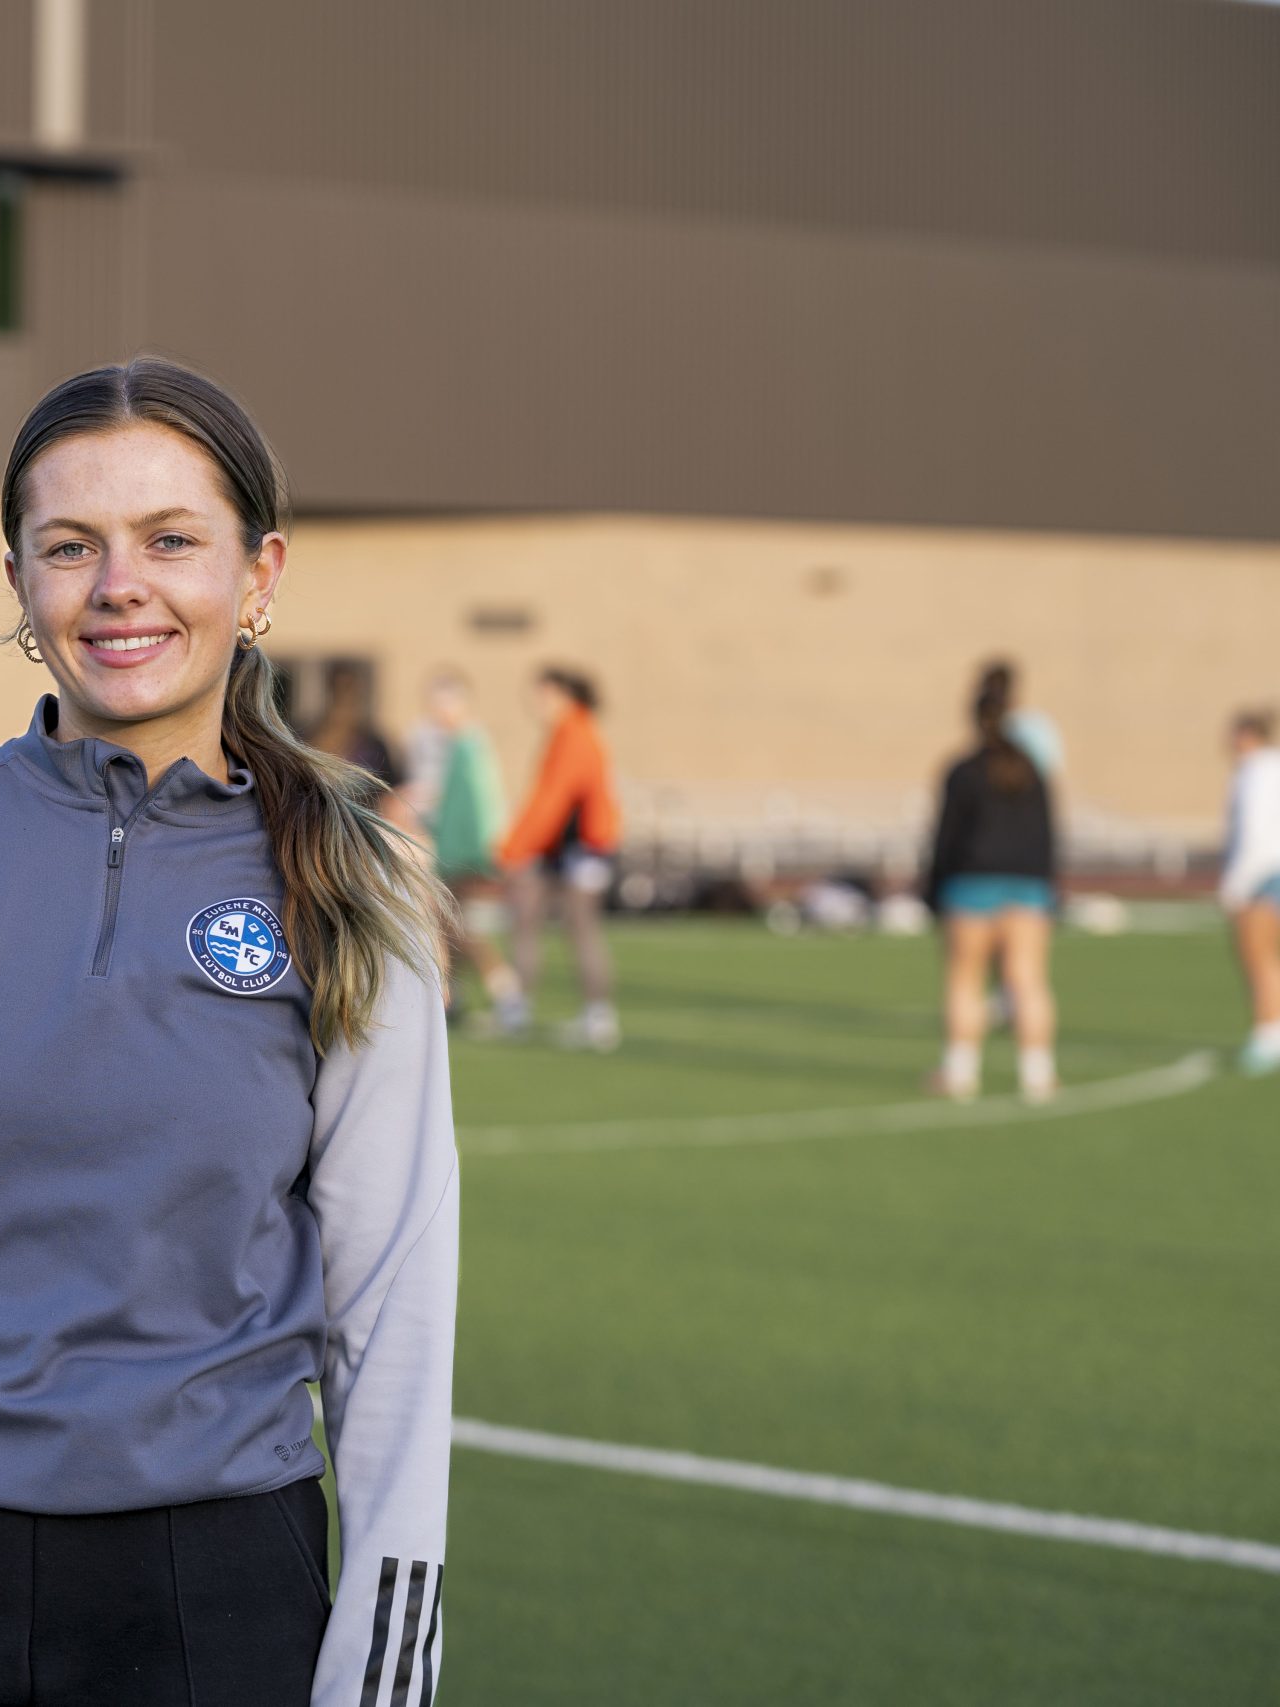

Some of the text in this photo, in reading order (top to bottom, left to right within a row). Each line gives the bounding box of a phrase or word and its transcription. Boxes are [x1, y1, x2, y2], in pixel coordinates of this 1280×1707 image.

[204, 902, 283, 937] EUGENE METRO
[192, 928, 203, 936] 20
[219, 920, 239, 938] EM
[244, 947, 260, 966] FC
[276, 951, 287, 960] 06
[242, 973, 271, 988] CLUB
